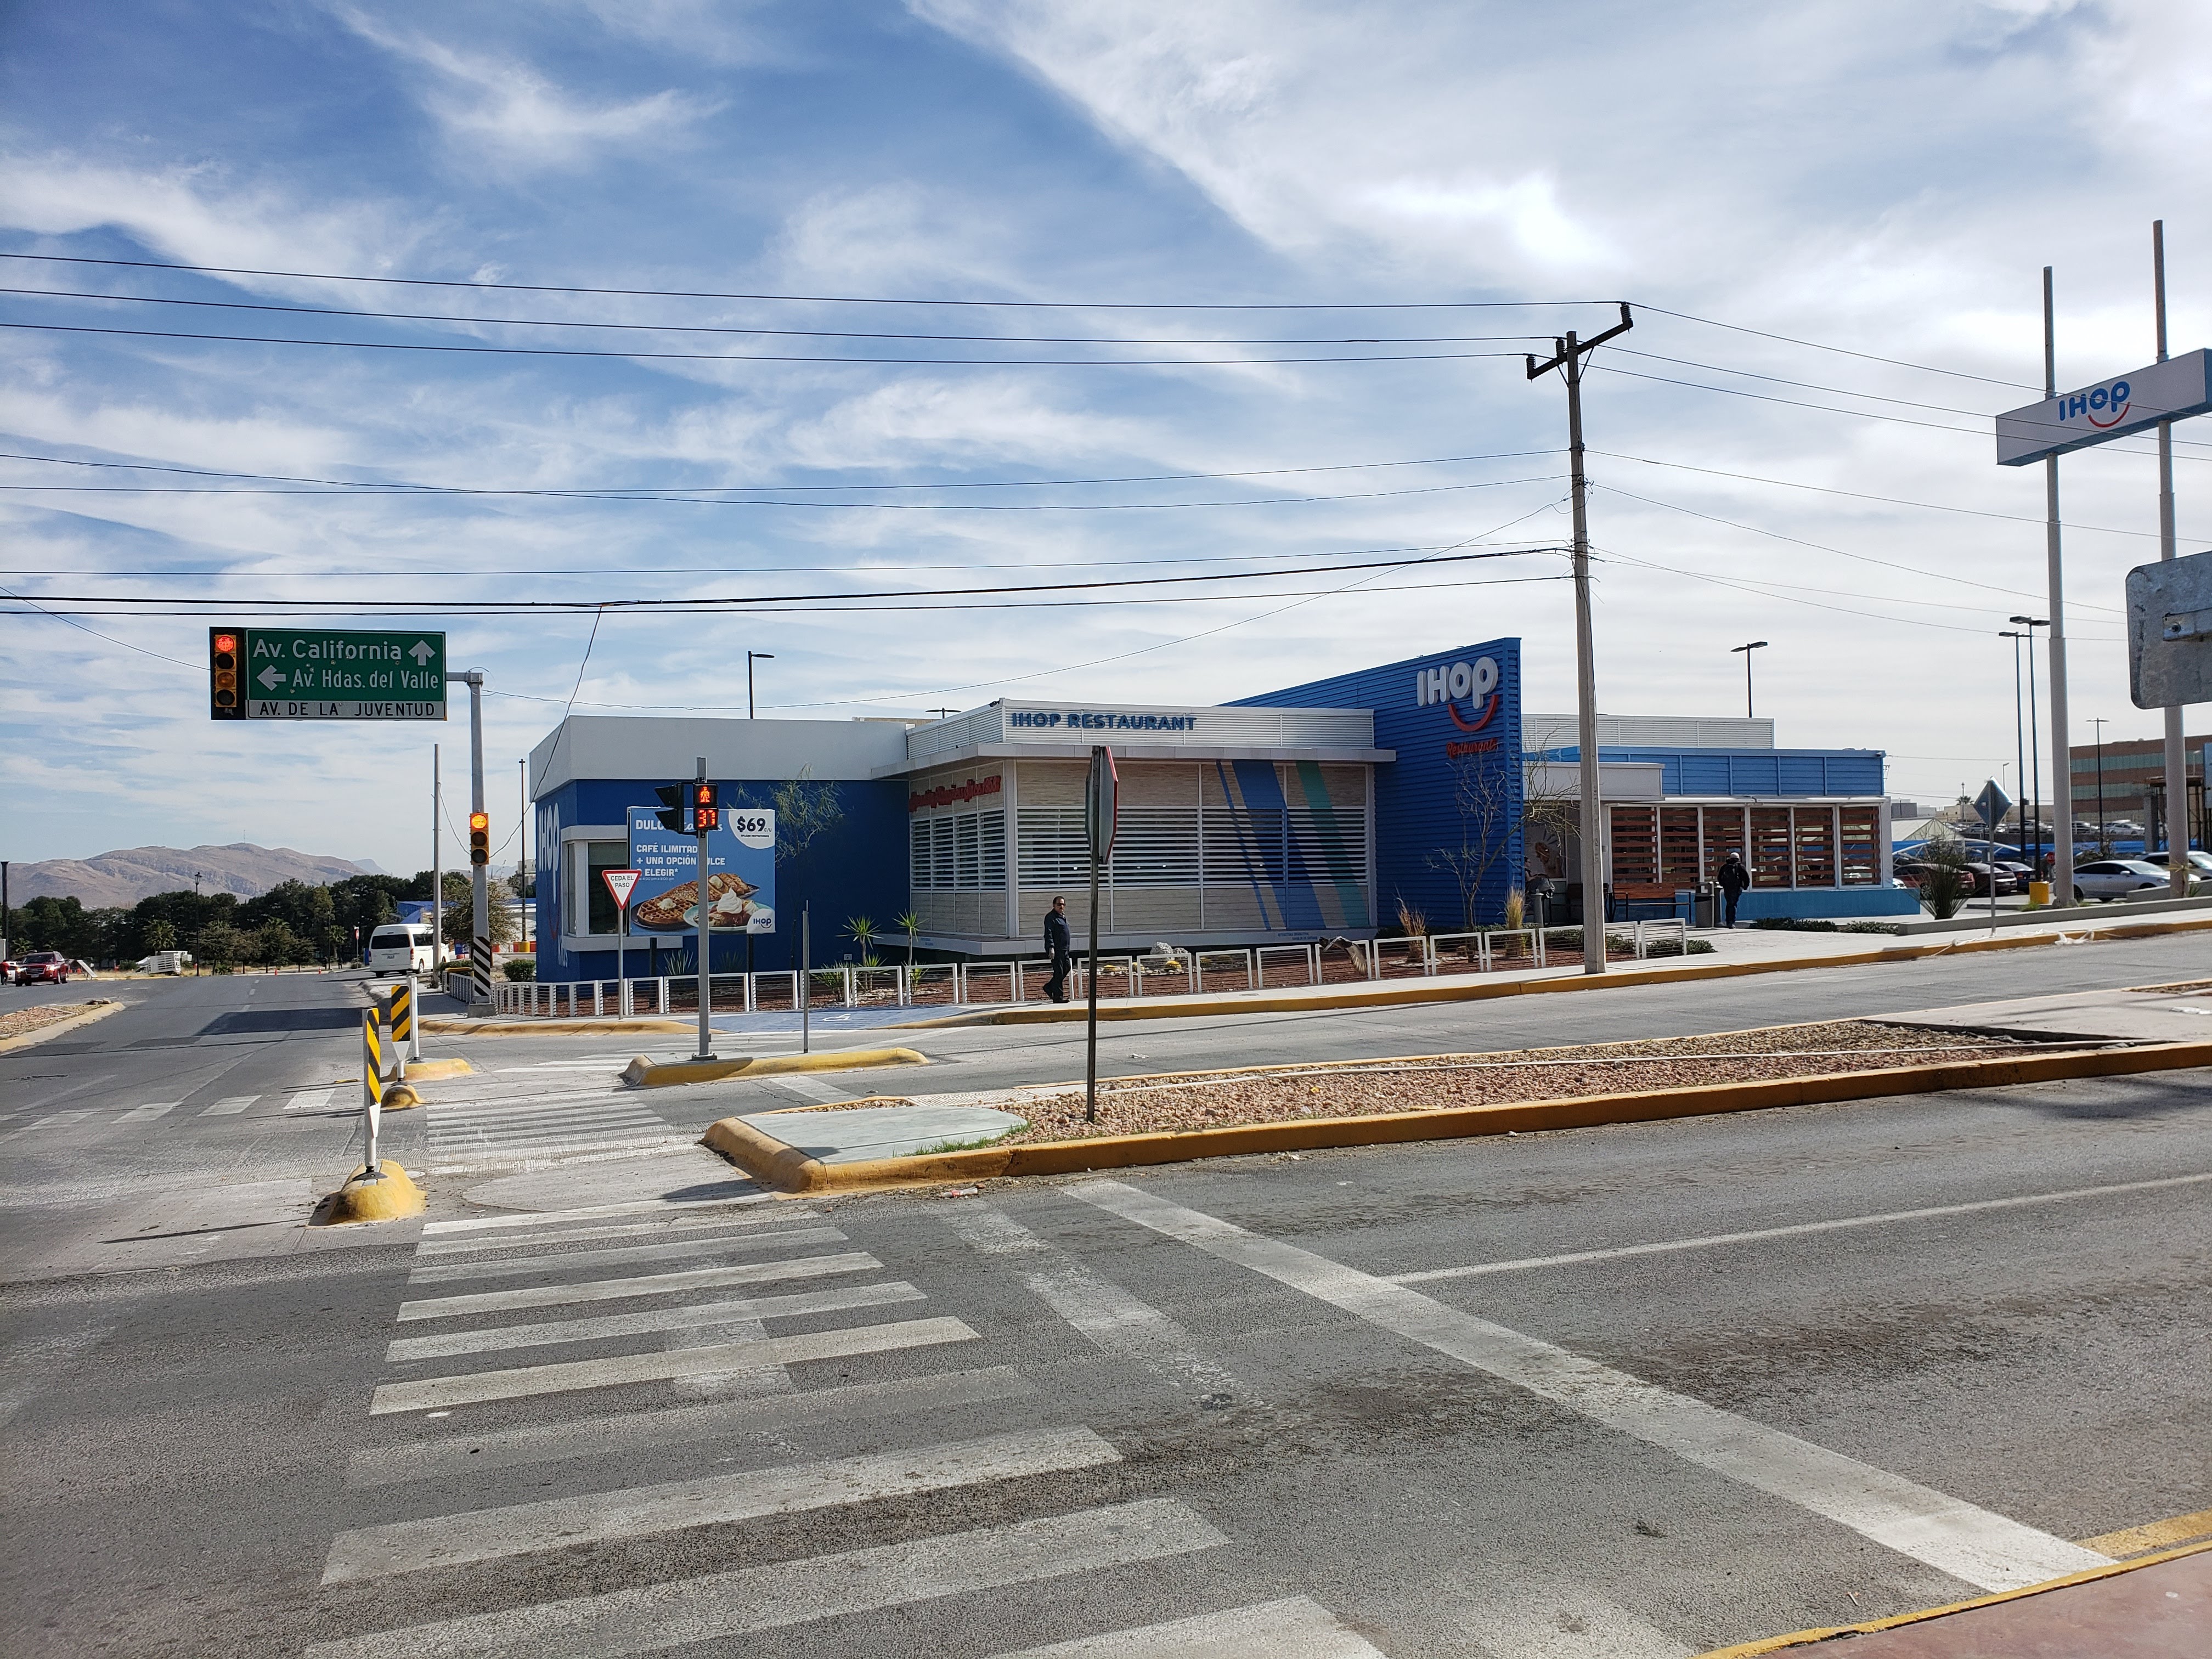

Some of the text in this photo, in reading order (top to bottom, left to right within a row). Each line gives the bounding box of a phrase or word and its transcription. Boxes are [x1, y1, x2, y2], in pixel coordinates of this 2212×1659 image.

[2059, 381, 2130, 421] IHOP
[253, 639, 401, 659] Av. California
[292, 669, 438, 689] Av. Hdas. del Valle
[1417, 657, 1498, 709] IHOP
[259, 702, 435, 716] AV. DE LA JUVENTUD
[1012, 713, 1197, 731] IHOP RESTAURANT
[636, 820, 664, 830] DULC
[698, 810, 715, 827] 37
[737, 816, 765, 832] $69
[636, 842, 698, 853] CAFÉ ILIMITAD
[646, 857, 663, 865] UNA
[667, 855, 697, 865] OPCIÓN
[753, 918, 772, 926] IHOP
